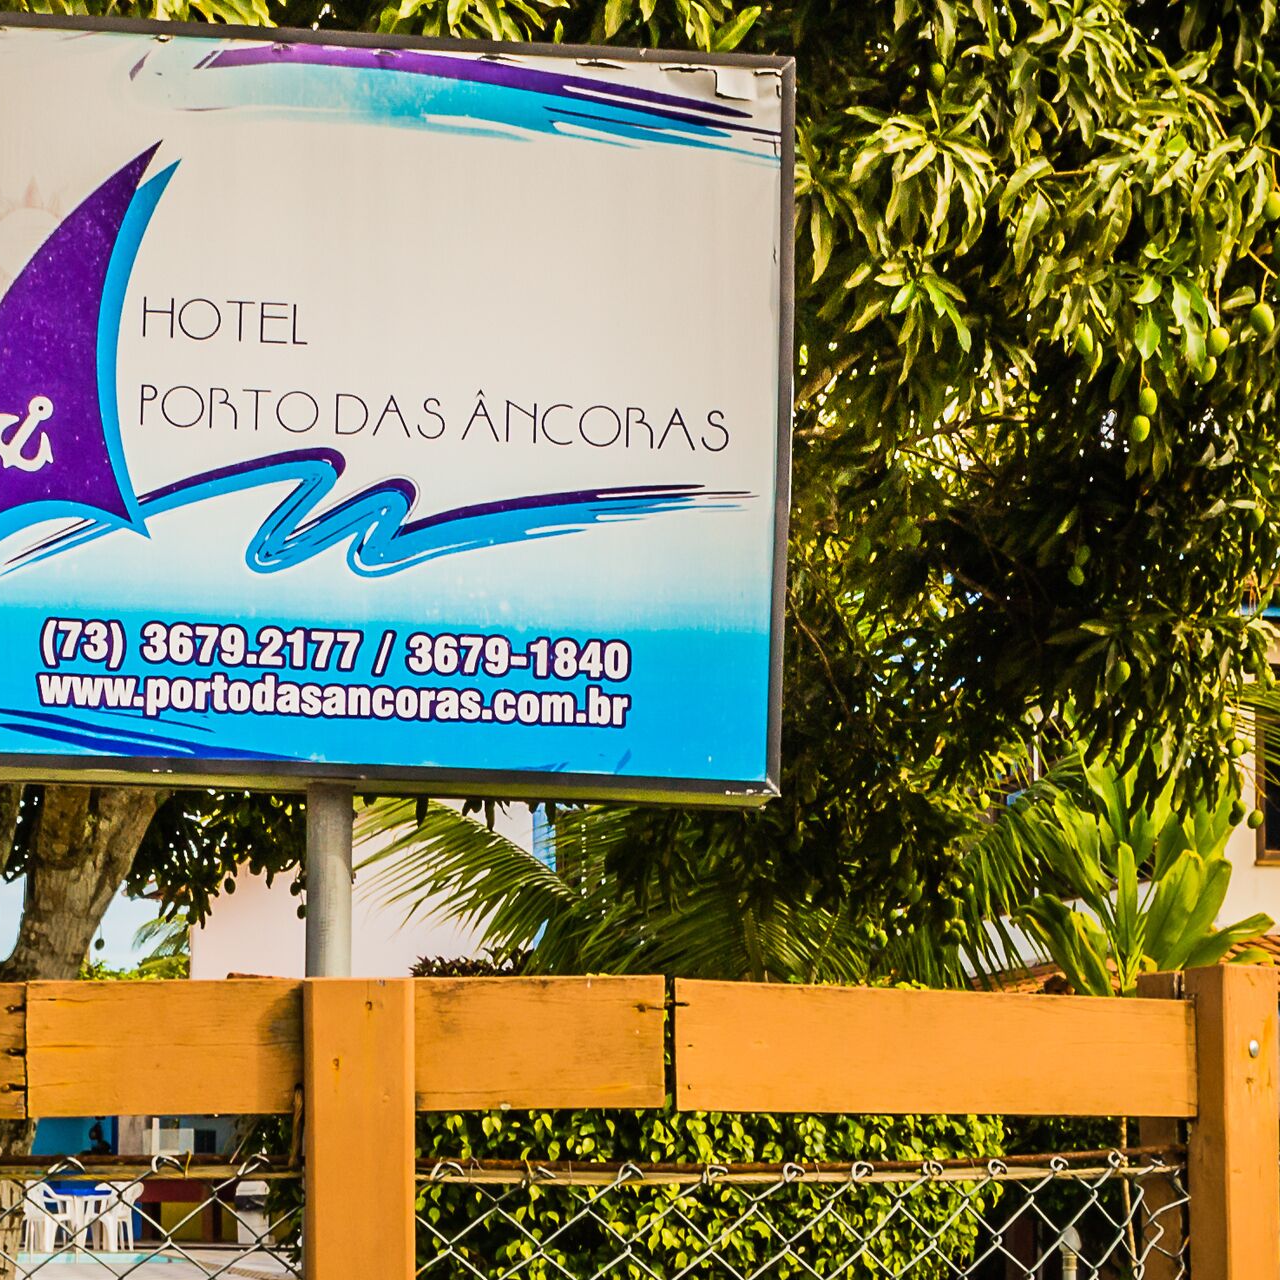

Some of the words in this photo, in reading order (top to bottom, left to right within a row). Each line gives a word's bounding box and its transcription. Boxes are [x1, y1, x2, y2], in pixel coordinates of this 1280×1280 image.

[142, 295, 309, 346] HOTEL
[139, 383, 320, 434] PORTO
[334, 392, 447, 440] DAS
[460, 388, 730, 452] ÂNCORAS
[41, 618, 125, 669] (73)
[142, 622, 362, 670] 3679.2177
[407, 633, 630, 680] 3679-1840
[37, 672, 630, 727] www.portodasancoras.com.br
